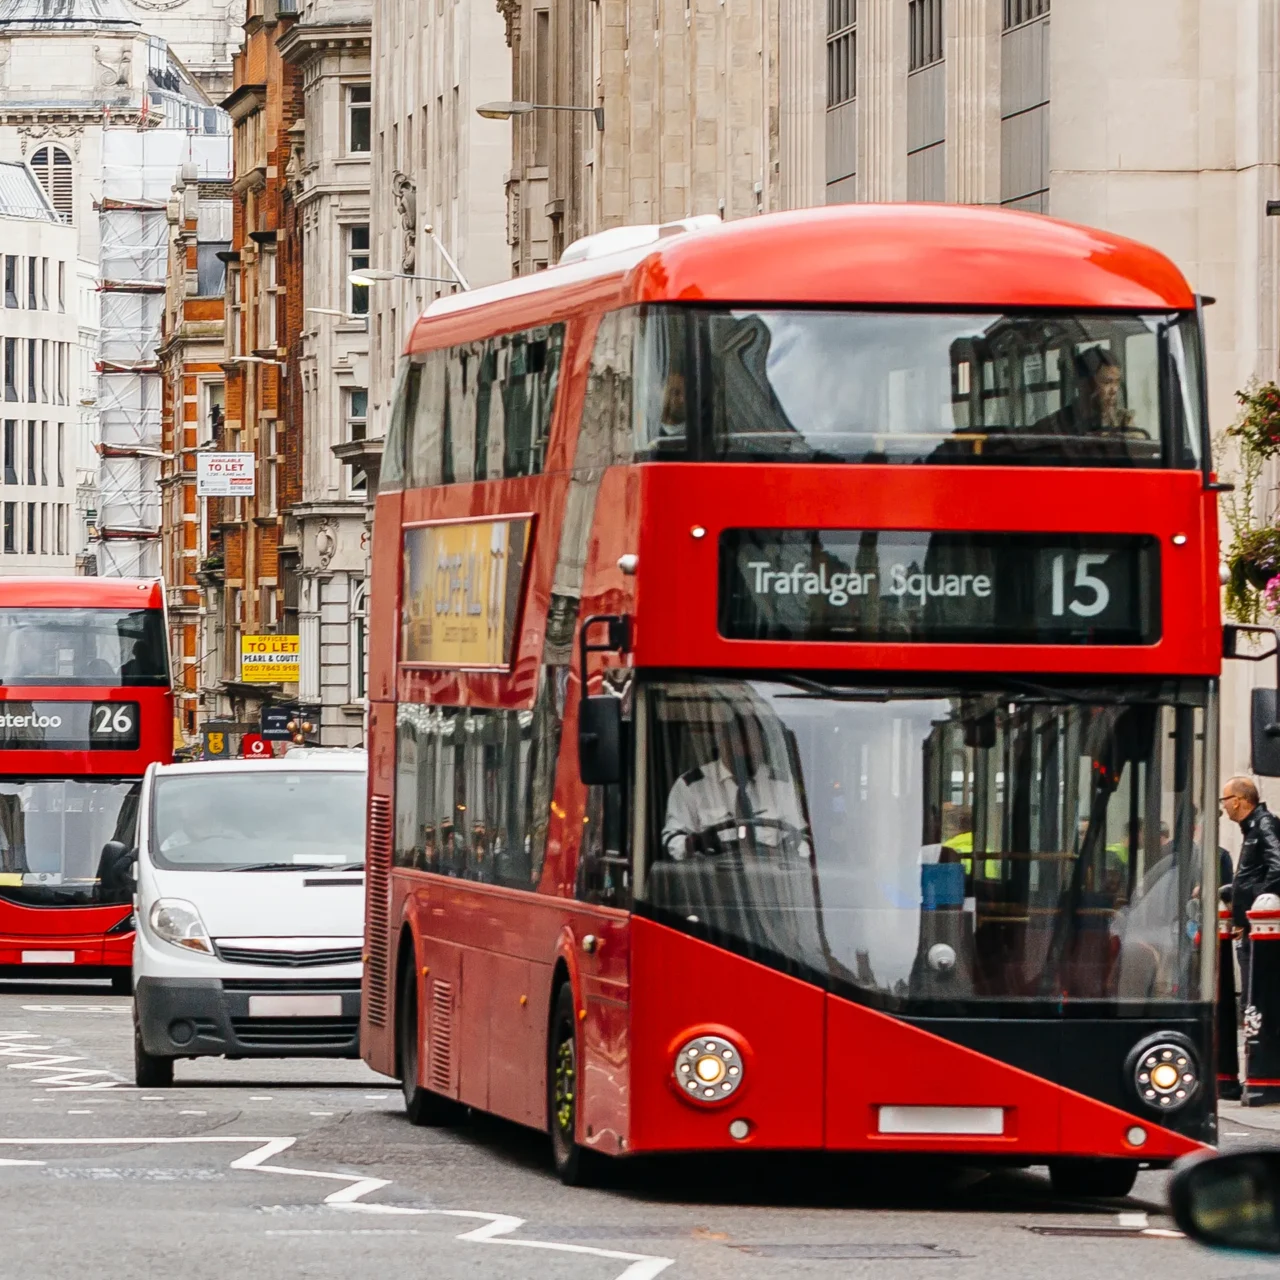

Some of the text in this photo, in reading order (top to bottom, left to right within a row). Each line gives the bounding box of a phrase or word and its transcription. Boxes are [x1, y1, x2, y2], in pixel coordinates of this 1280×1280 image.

[747, 554, 1110, 617] Trafalgar Square 15
[248, 642, 298, 652] TO LET
[243, 654, 300, 662] PEARL & COUTT
[95, 705, 132, 733] 26
